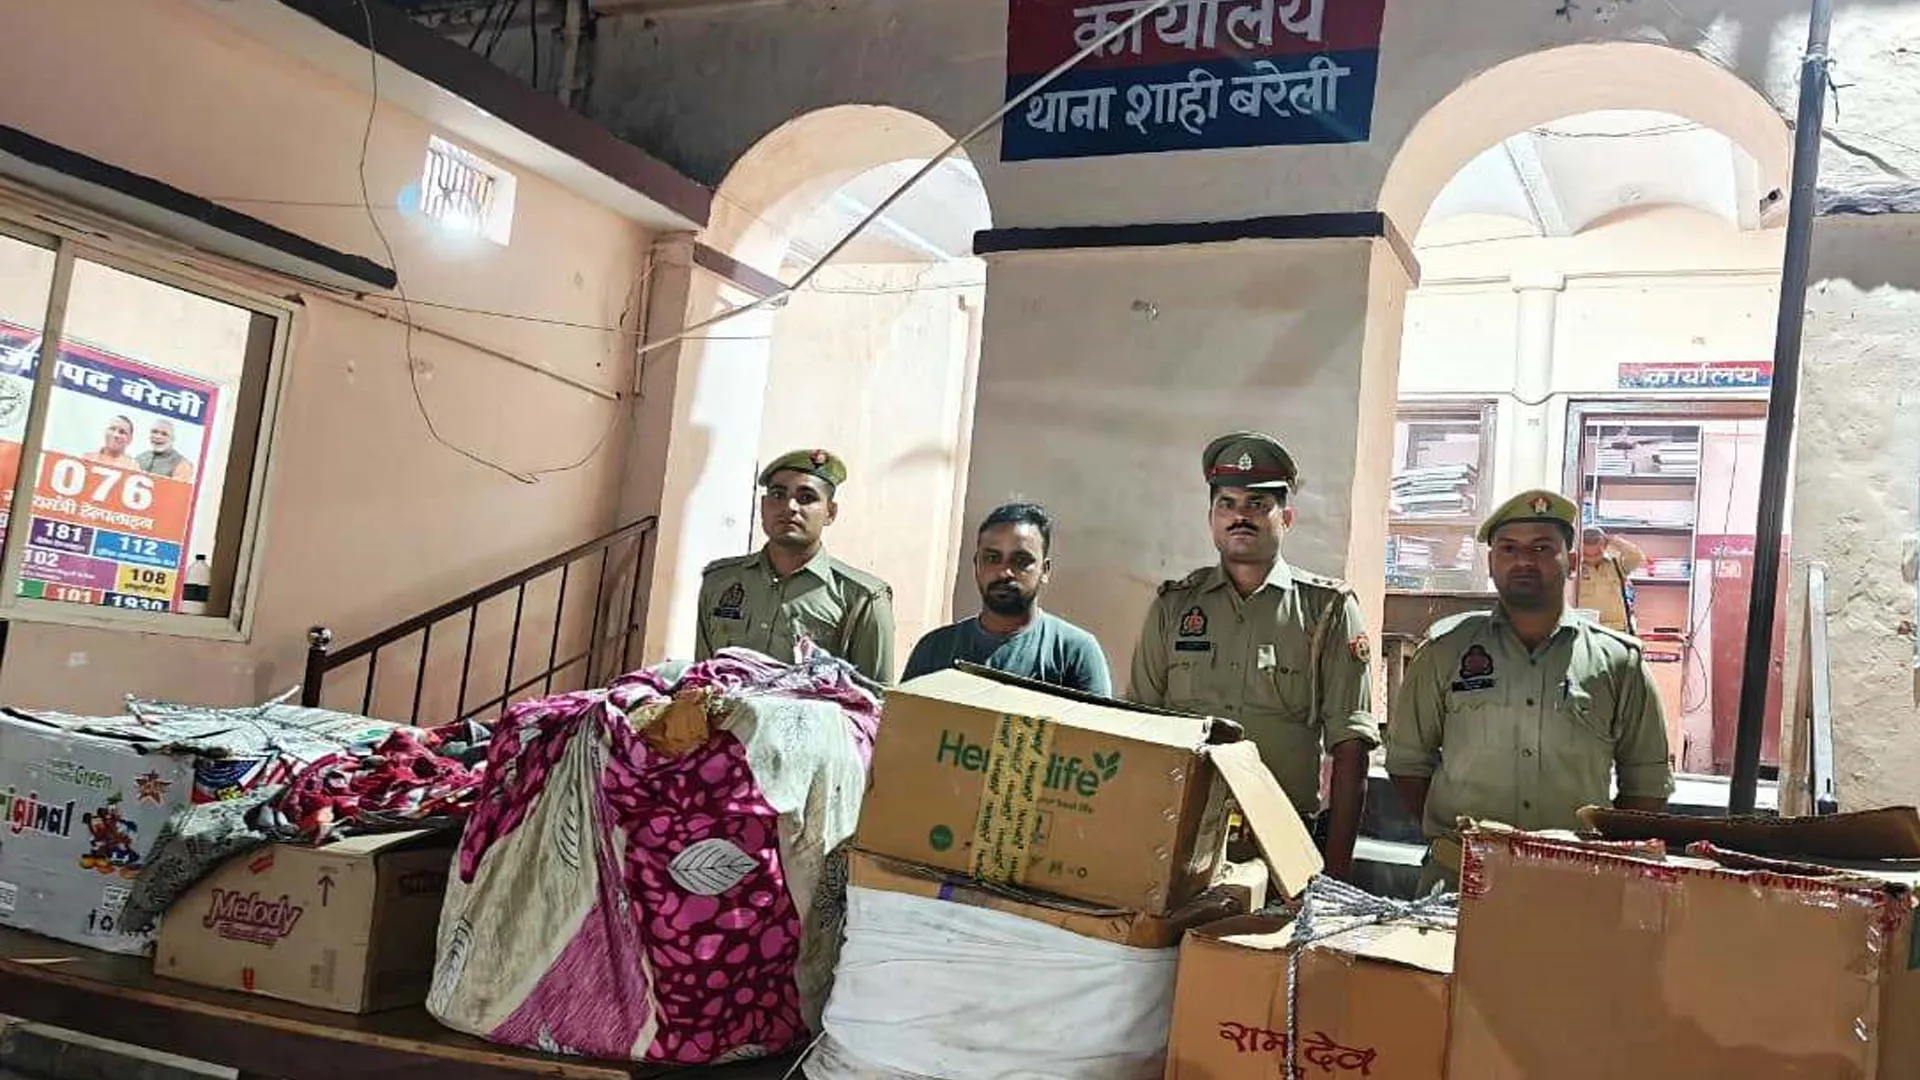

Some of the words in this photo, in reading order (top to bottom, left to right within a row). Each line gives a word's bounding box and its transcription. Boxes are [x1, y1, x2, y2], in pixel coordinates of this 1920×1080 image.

[1026, 87, 1117, 133] थाना
[1125, 68, 1224, 134] शाही
[1229, 56, 1351, 118] बरेली
[1643, 362, 1758, 385] कार्यालय
[44, 522, 82, 542] 181
[120, 536, 159, 555] 112
[24, 550, 59, 567] 102
[130, 568, 167, 585] 108
[56, 587, 92, 602] 101
[204, 889, 303, 938] Melody
